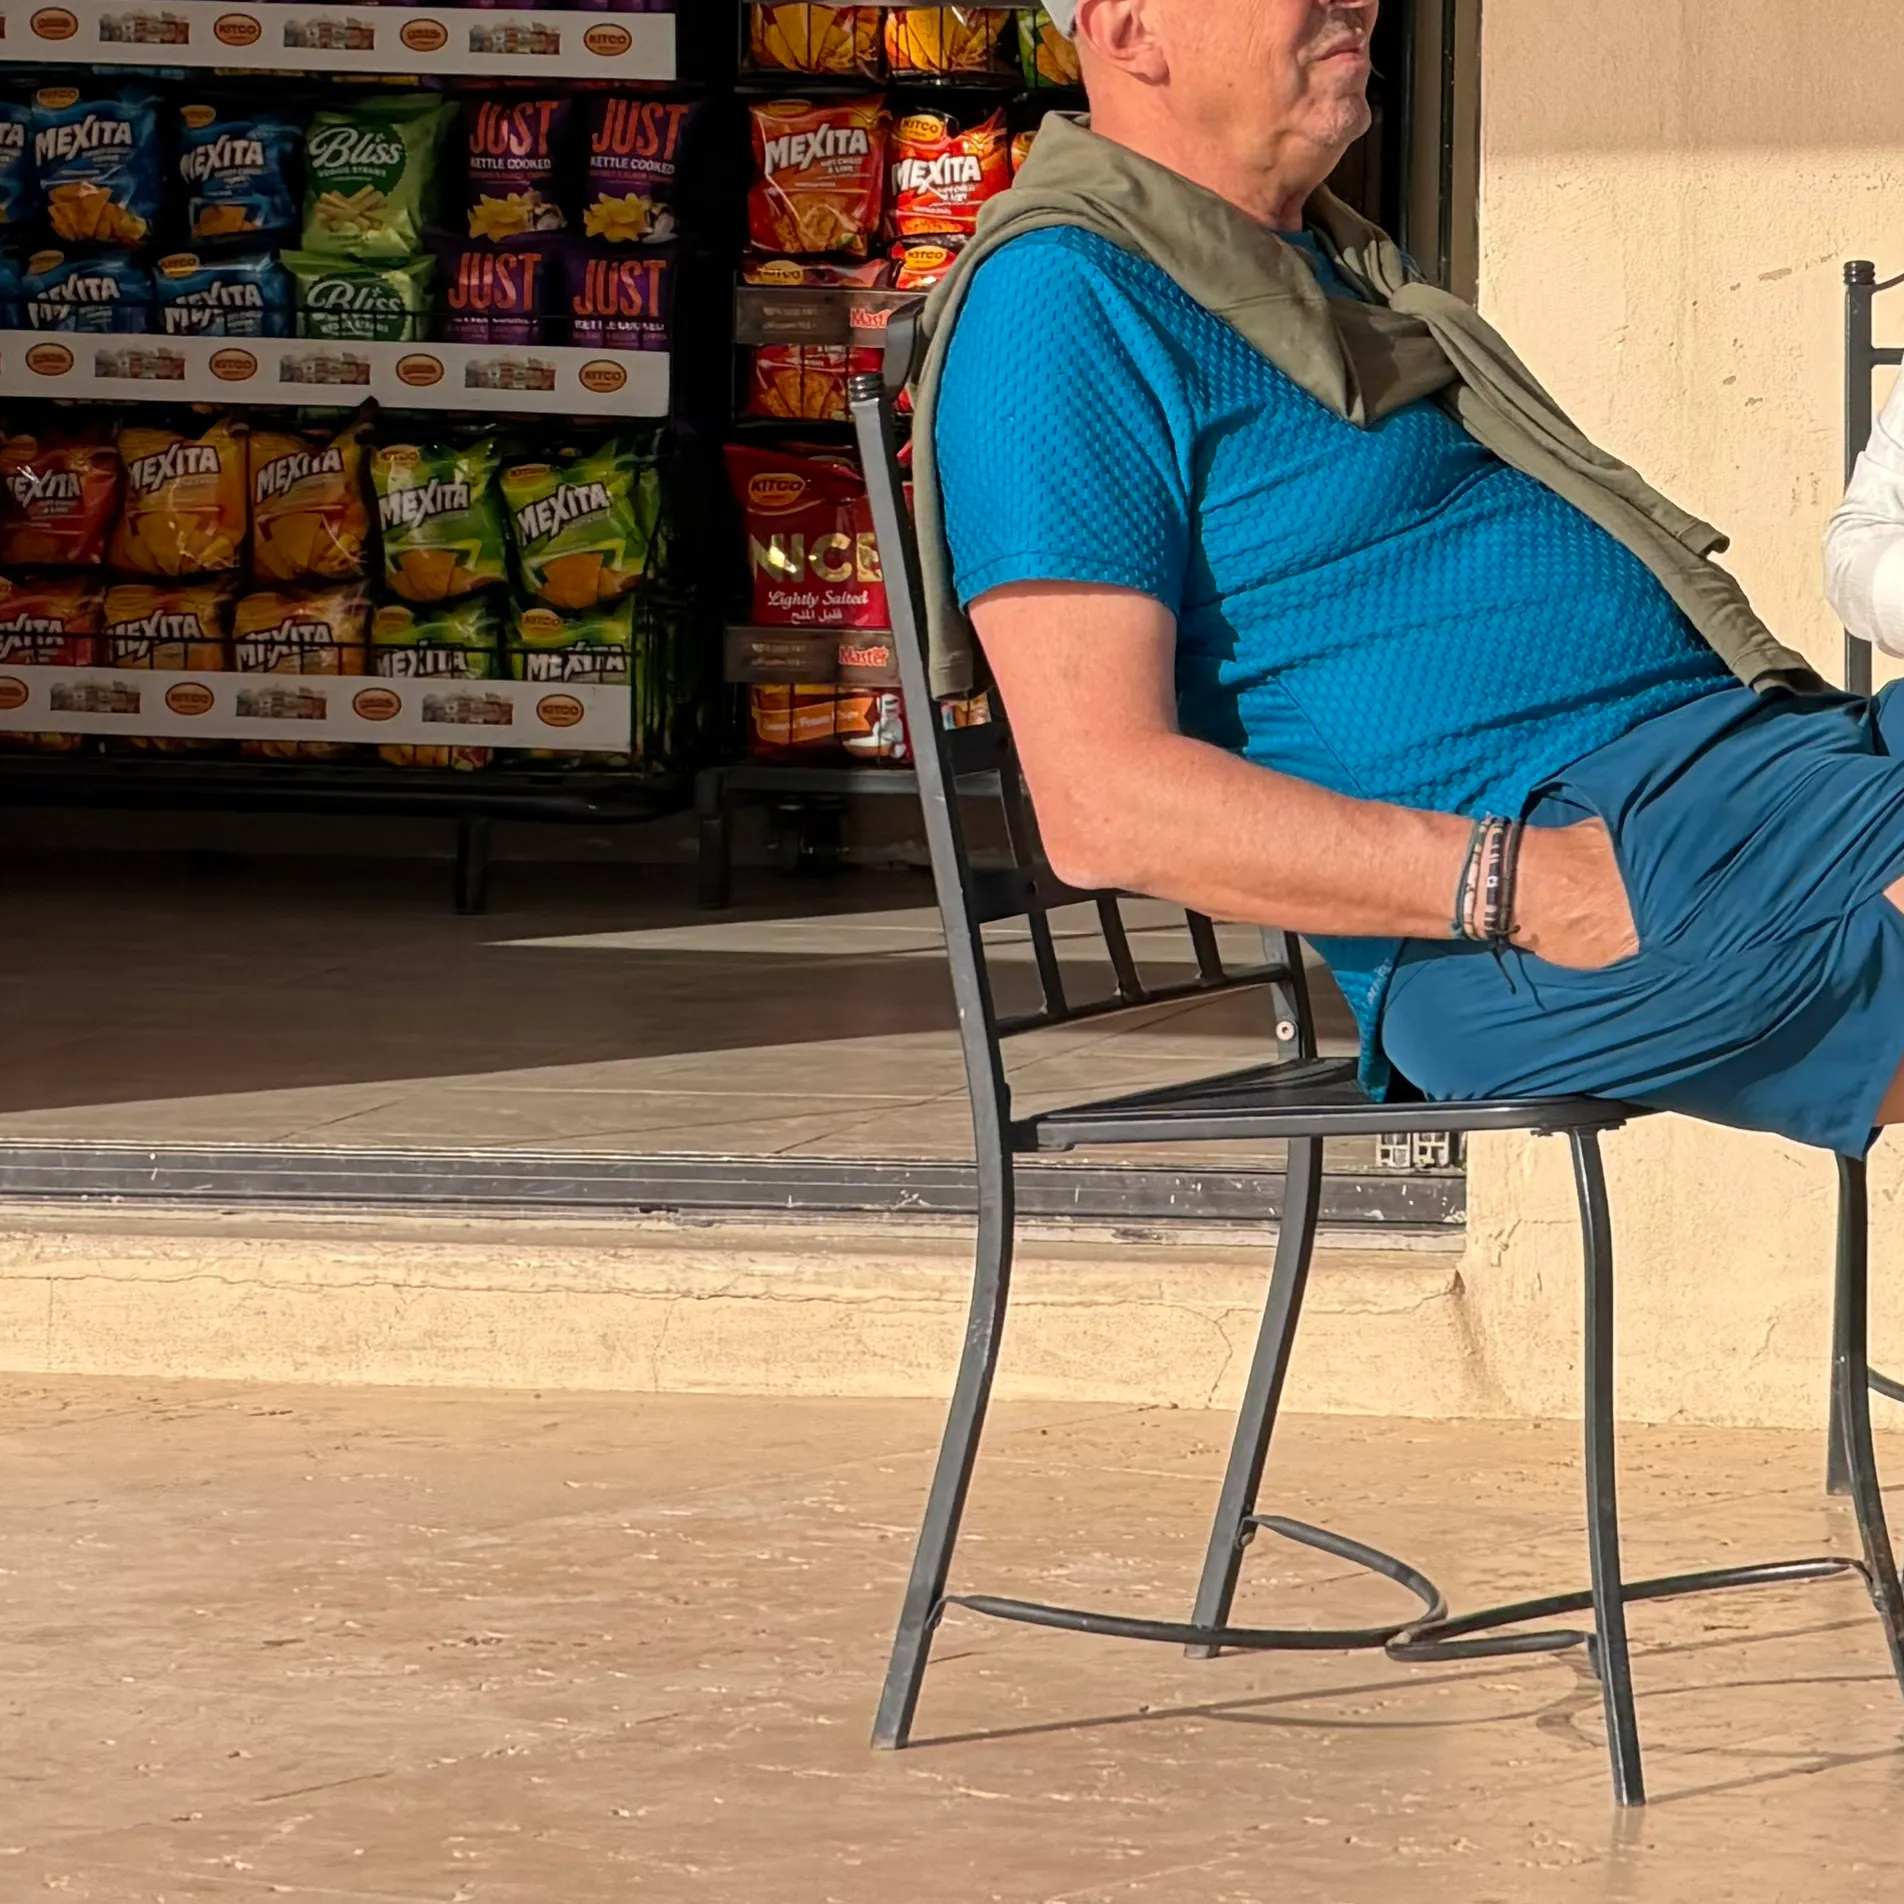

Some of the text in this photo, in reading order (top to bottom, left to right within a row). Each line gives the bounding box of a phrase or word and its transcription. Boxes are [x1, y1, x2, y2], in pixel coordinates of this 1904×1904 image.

[588, 35, 626, 46] KITCO
[35, 114, 133, 168] MEXITA
[308, 125, 403, 168] Bliss
[470, 100, 560, 157] JUST
[591, 98, 690, 161] JUST
[766, 122, 869, 174] MEXITA
[901, 118, 939, 134] KITCO
[180, 134, 265, 185] MEXITA
[470, 156, 552, 170] KETTLE COOKED
[590, 156, 676, 174] KETTLE COOKED
[892, 153, 982, 195] MEXITA
[908, 250, 944, 260] KITCO
[447, 251, 543, 312] JUST
[571, 259, 668, 318] JUST
[850, 308, 888, 329] Mast
[129, 442, 220, 494] MEXITA
[256, 448, 343, 506] MEXITA
[751, 478, 802, 493] KITCO
[378, 479, 470, 530] MEXITA
[517, 482, 611, 546] MEXITA
[749, 532, 883, 583] NICE
[767, 589, 869, 609] Lightly Salted
[839, 644, 889, 666] Master
[541, 704, 579, 716] KITCO
